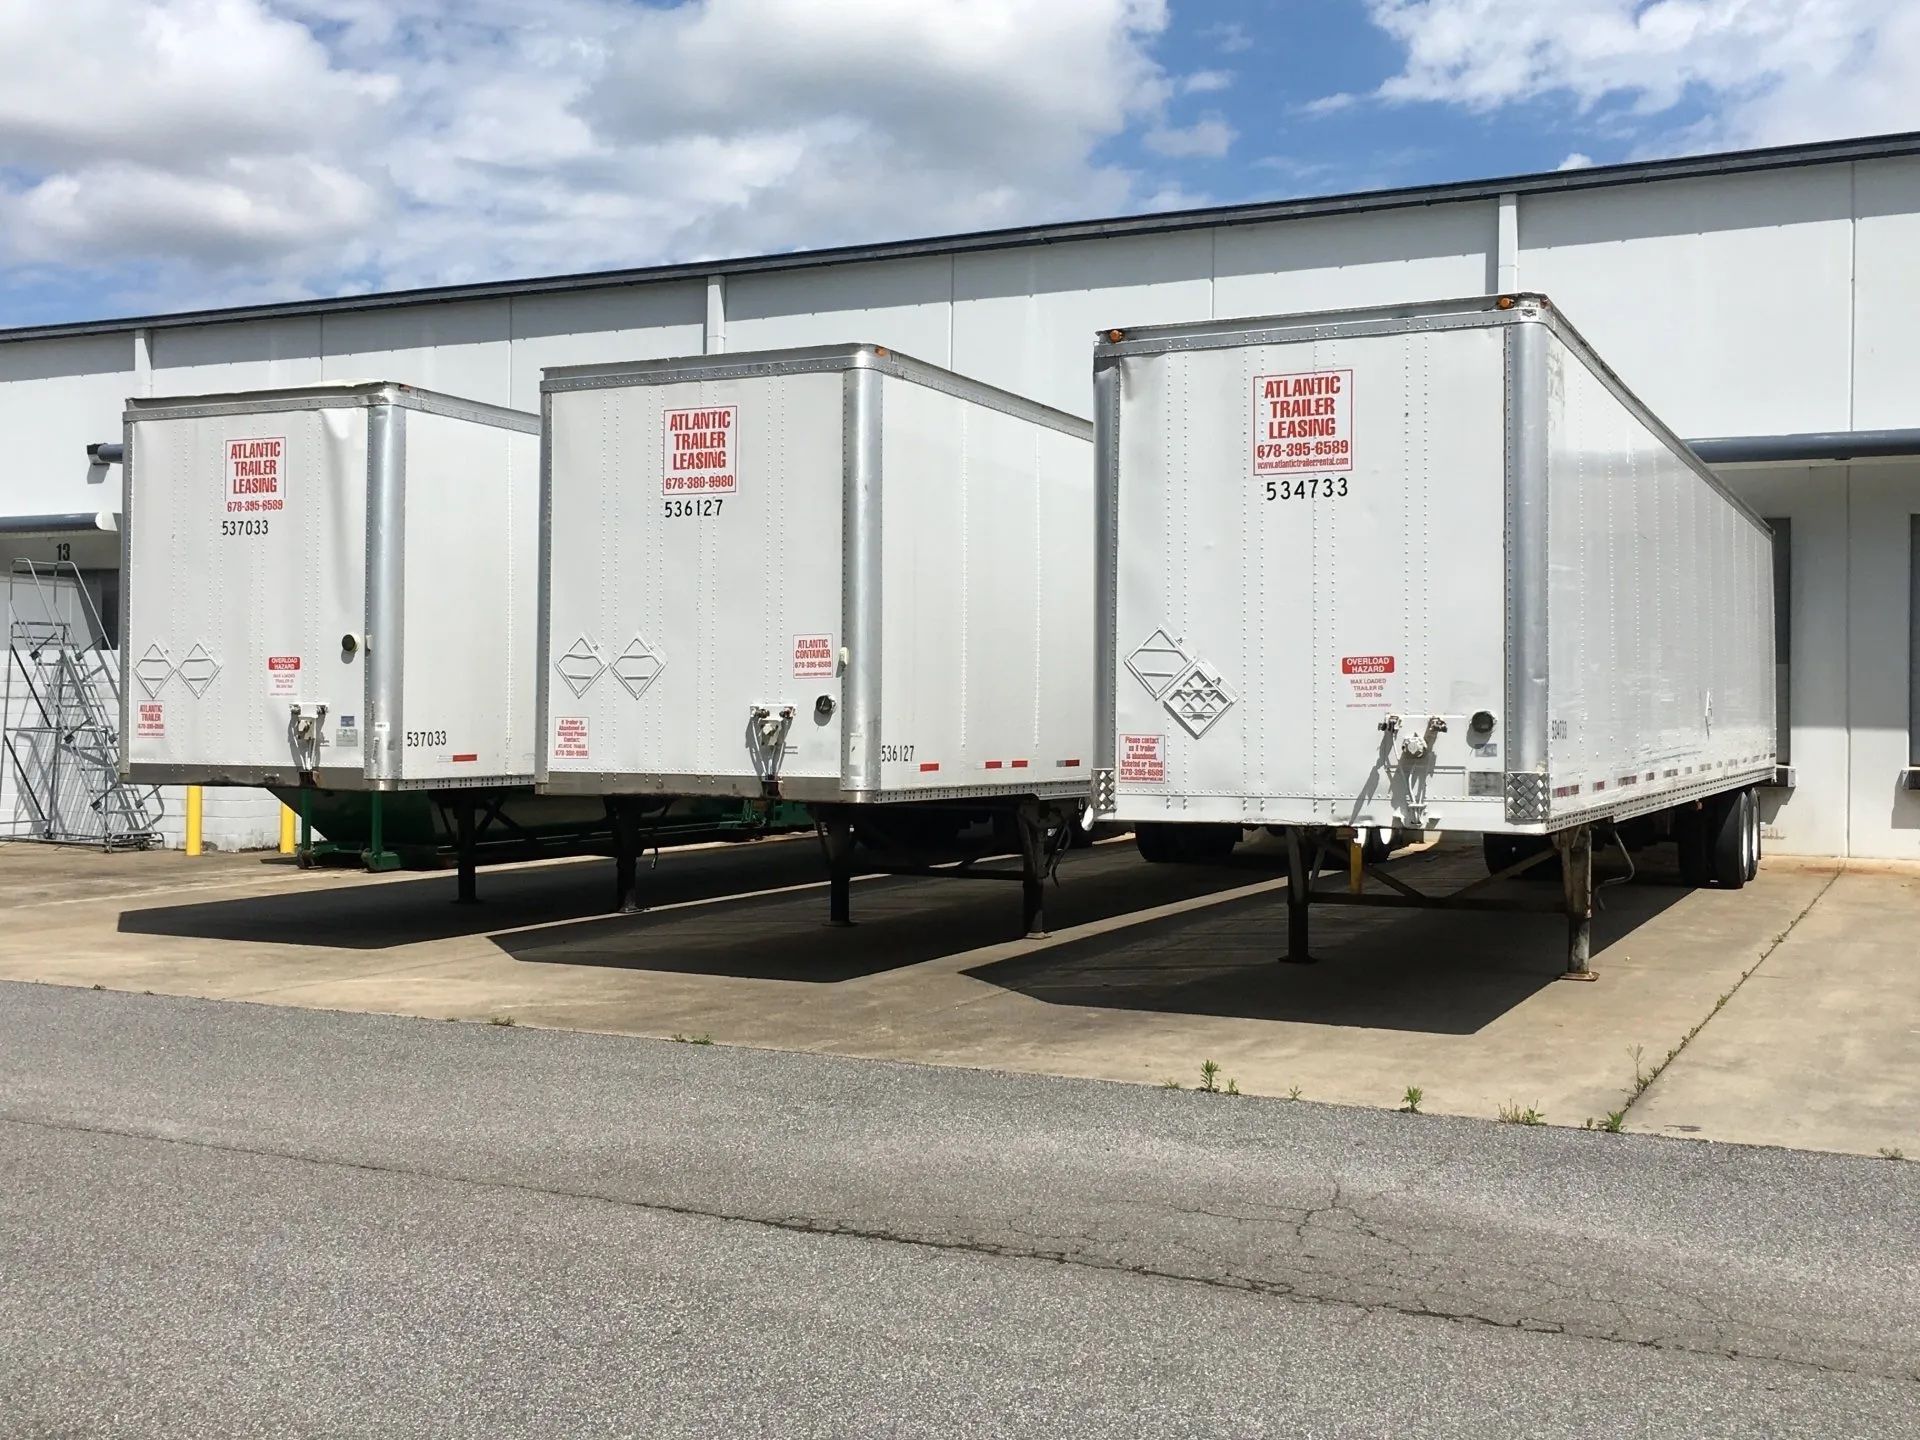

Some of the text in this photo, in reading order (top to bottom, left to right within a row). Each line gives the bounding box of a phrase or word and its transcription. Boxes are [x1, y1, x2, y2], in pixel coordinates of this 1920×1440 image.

[1264, 375, 1341, 398] ATLANTIC
[1270, 397, 1335, 418] TRAILER
[670, 410, 731, 431] ATLANTIC
[1269, 418, 1336, 439] LEASING
[674, 431, 726, 450] TRAILER
[1257, 440, 1348, 458] 678-395-6589
[230, 441, 281, 459] ATLANTIC
[234, 460, 276, 476] TRAILER
[673, 451, 726, 470] LEASING
[233, 477, 277, 494] LEASING
[665, 474, 734, 489] 678-380-9980
[1266, 477, 1348, 501] 534733
[227, 499, 283, 512] 678-395-6589
[664, 499, 723, 518] 536127
[222, 519, 269, 536] 537033
[56, 543, 71, 561] 13
[797, 638, 829, 649] ATLANTIC
[795, 649, 831, 659] CONTAINER
[1346, 657, 1390, 665] OVERLOAD
[1351, 665, 1385, 673] HAZARD
[141, 713, 161, 721] TRAILER
[407, 730, 447, 747] 537033
[1125, 736, 1141, 744] Please
[881, 745, 915, 762] 536127
